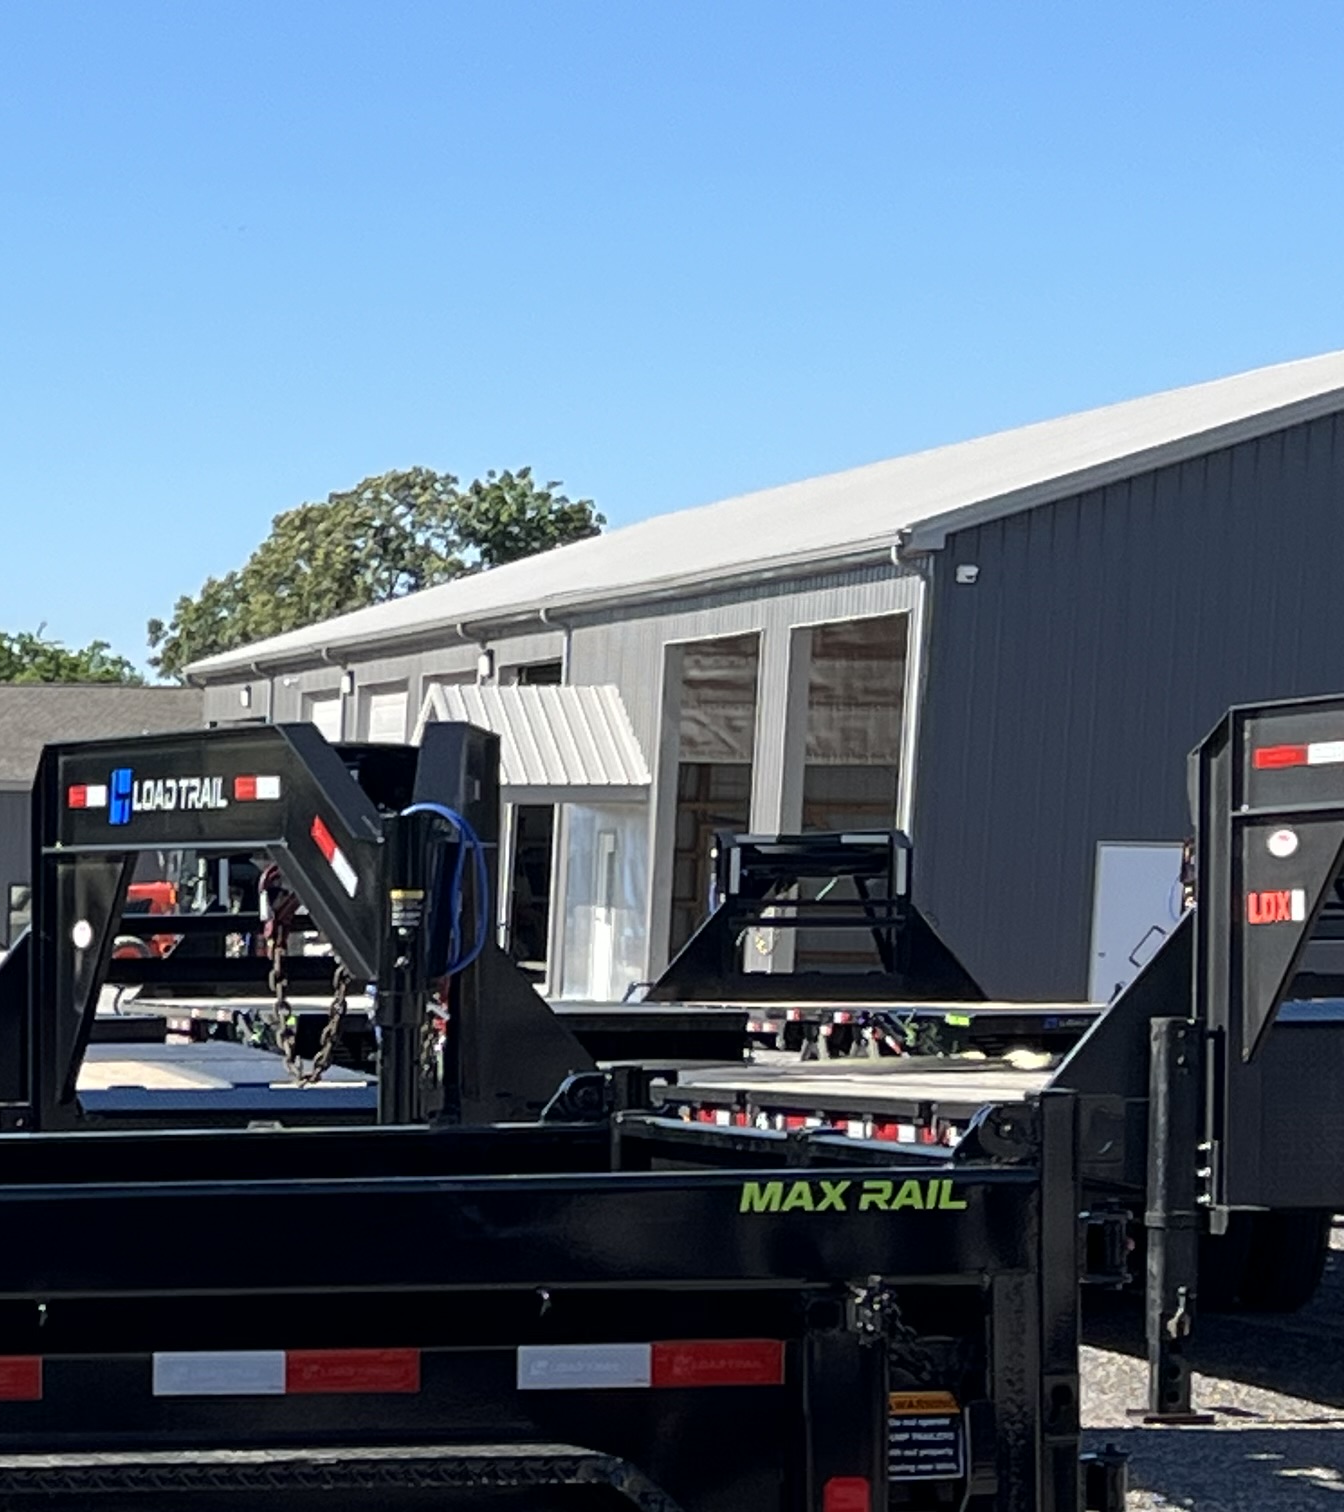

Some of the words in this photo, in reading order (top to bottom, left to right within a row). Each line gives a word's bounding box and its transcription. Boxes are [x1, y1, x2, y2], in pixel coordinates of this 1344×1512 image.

[132, 778, 177, 812] LOAD
[178, 776, 228, 810] TRAIL
[1247, 890, 1291, 924] LDX
[739, 1180, 851, 1213] MAX
[858, 1179, 968, 1211] RAIL
